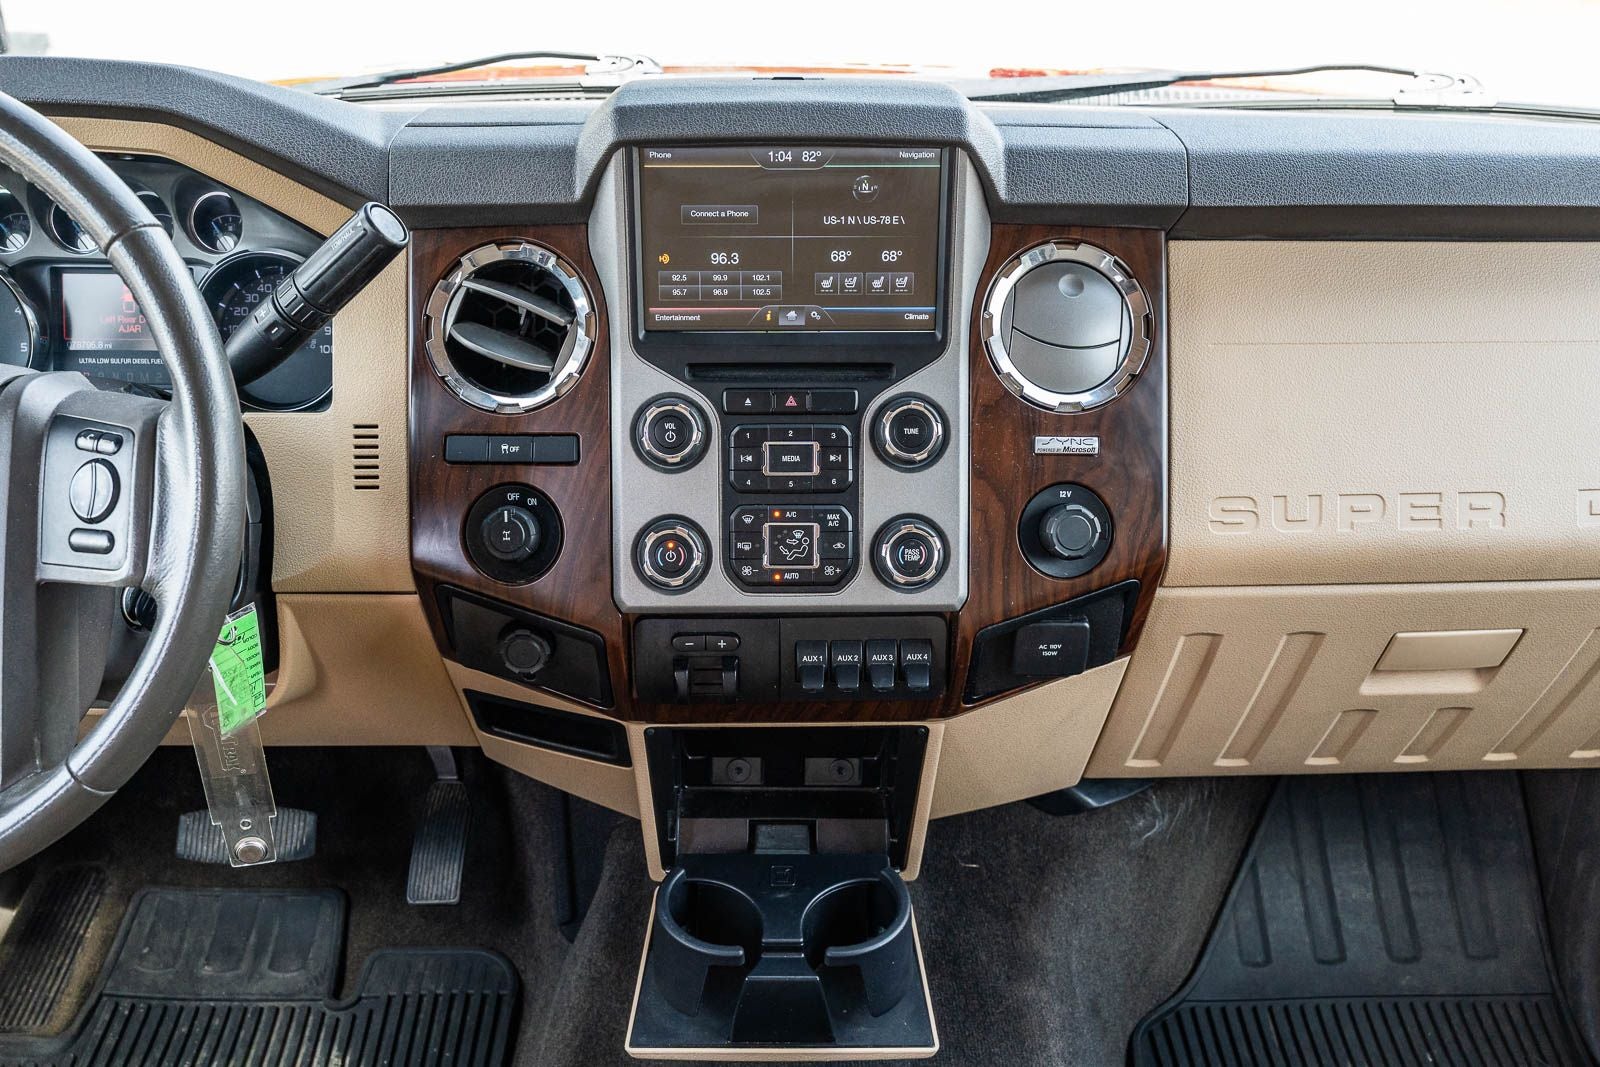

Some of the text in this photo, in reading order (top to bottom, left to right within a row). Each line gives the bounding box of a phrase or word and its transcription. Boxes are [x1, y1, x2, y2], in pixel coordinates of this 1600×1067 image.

[649, 151, 671, 159] Phone
[768, 151, 821, 162] 1:04 82°
[899, 151, 935, 159] Navigation
[690, 210, 720, 218] Connect
[727, 210, 749, 218] Phone
[823, 216, 845, 225] US-1
[848, 216, 855, 225] N
[864, 215, 890, 225] US-78
[893, 216, 898, 225] E
[711, 253, 739, 265] 96.3
[831, 251, 851, 261] 68°
[881, 251, 902, 261] 68°
[257, 284, 272, 292] 40
[245, 294, 259, 302] 30
[15, 306, 21, 314] 4
[234, 307, 248, 315] 20
[20, 343, 27, 351] 5
[1208, 491, 1509, 534] SUPER
